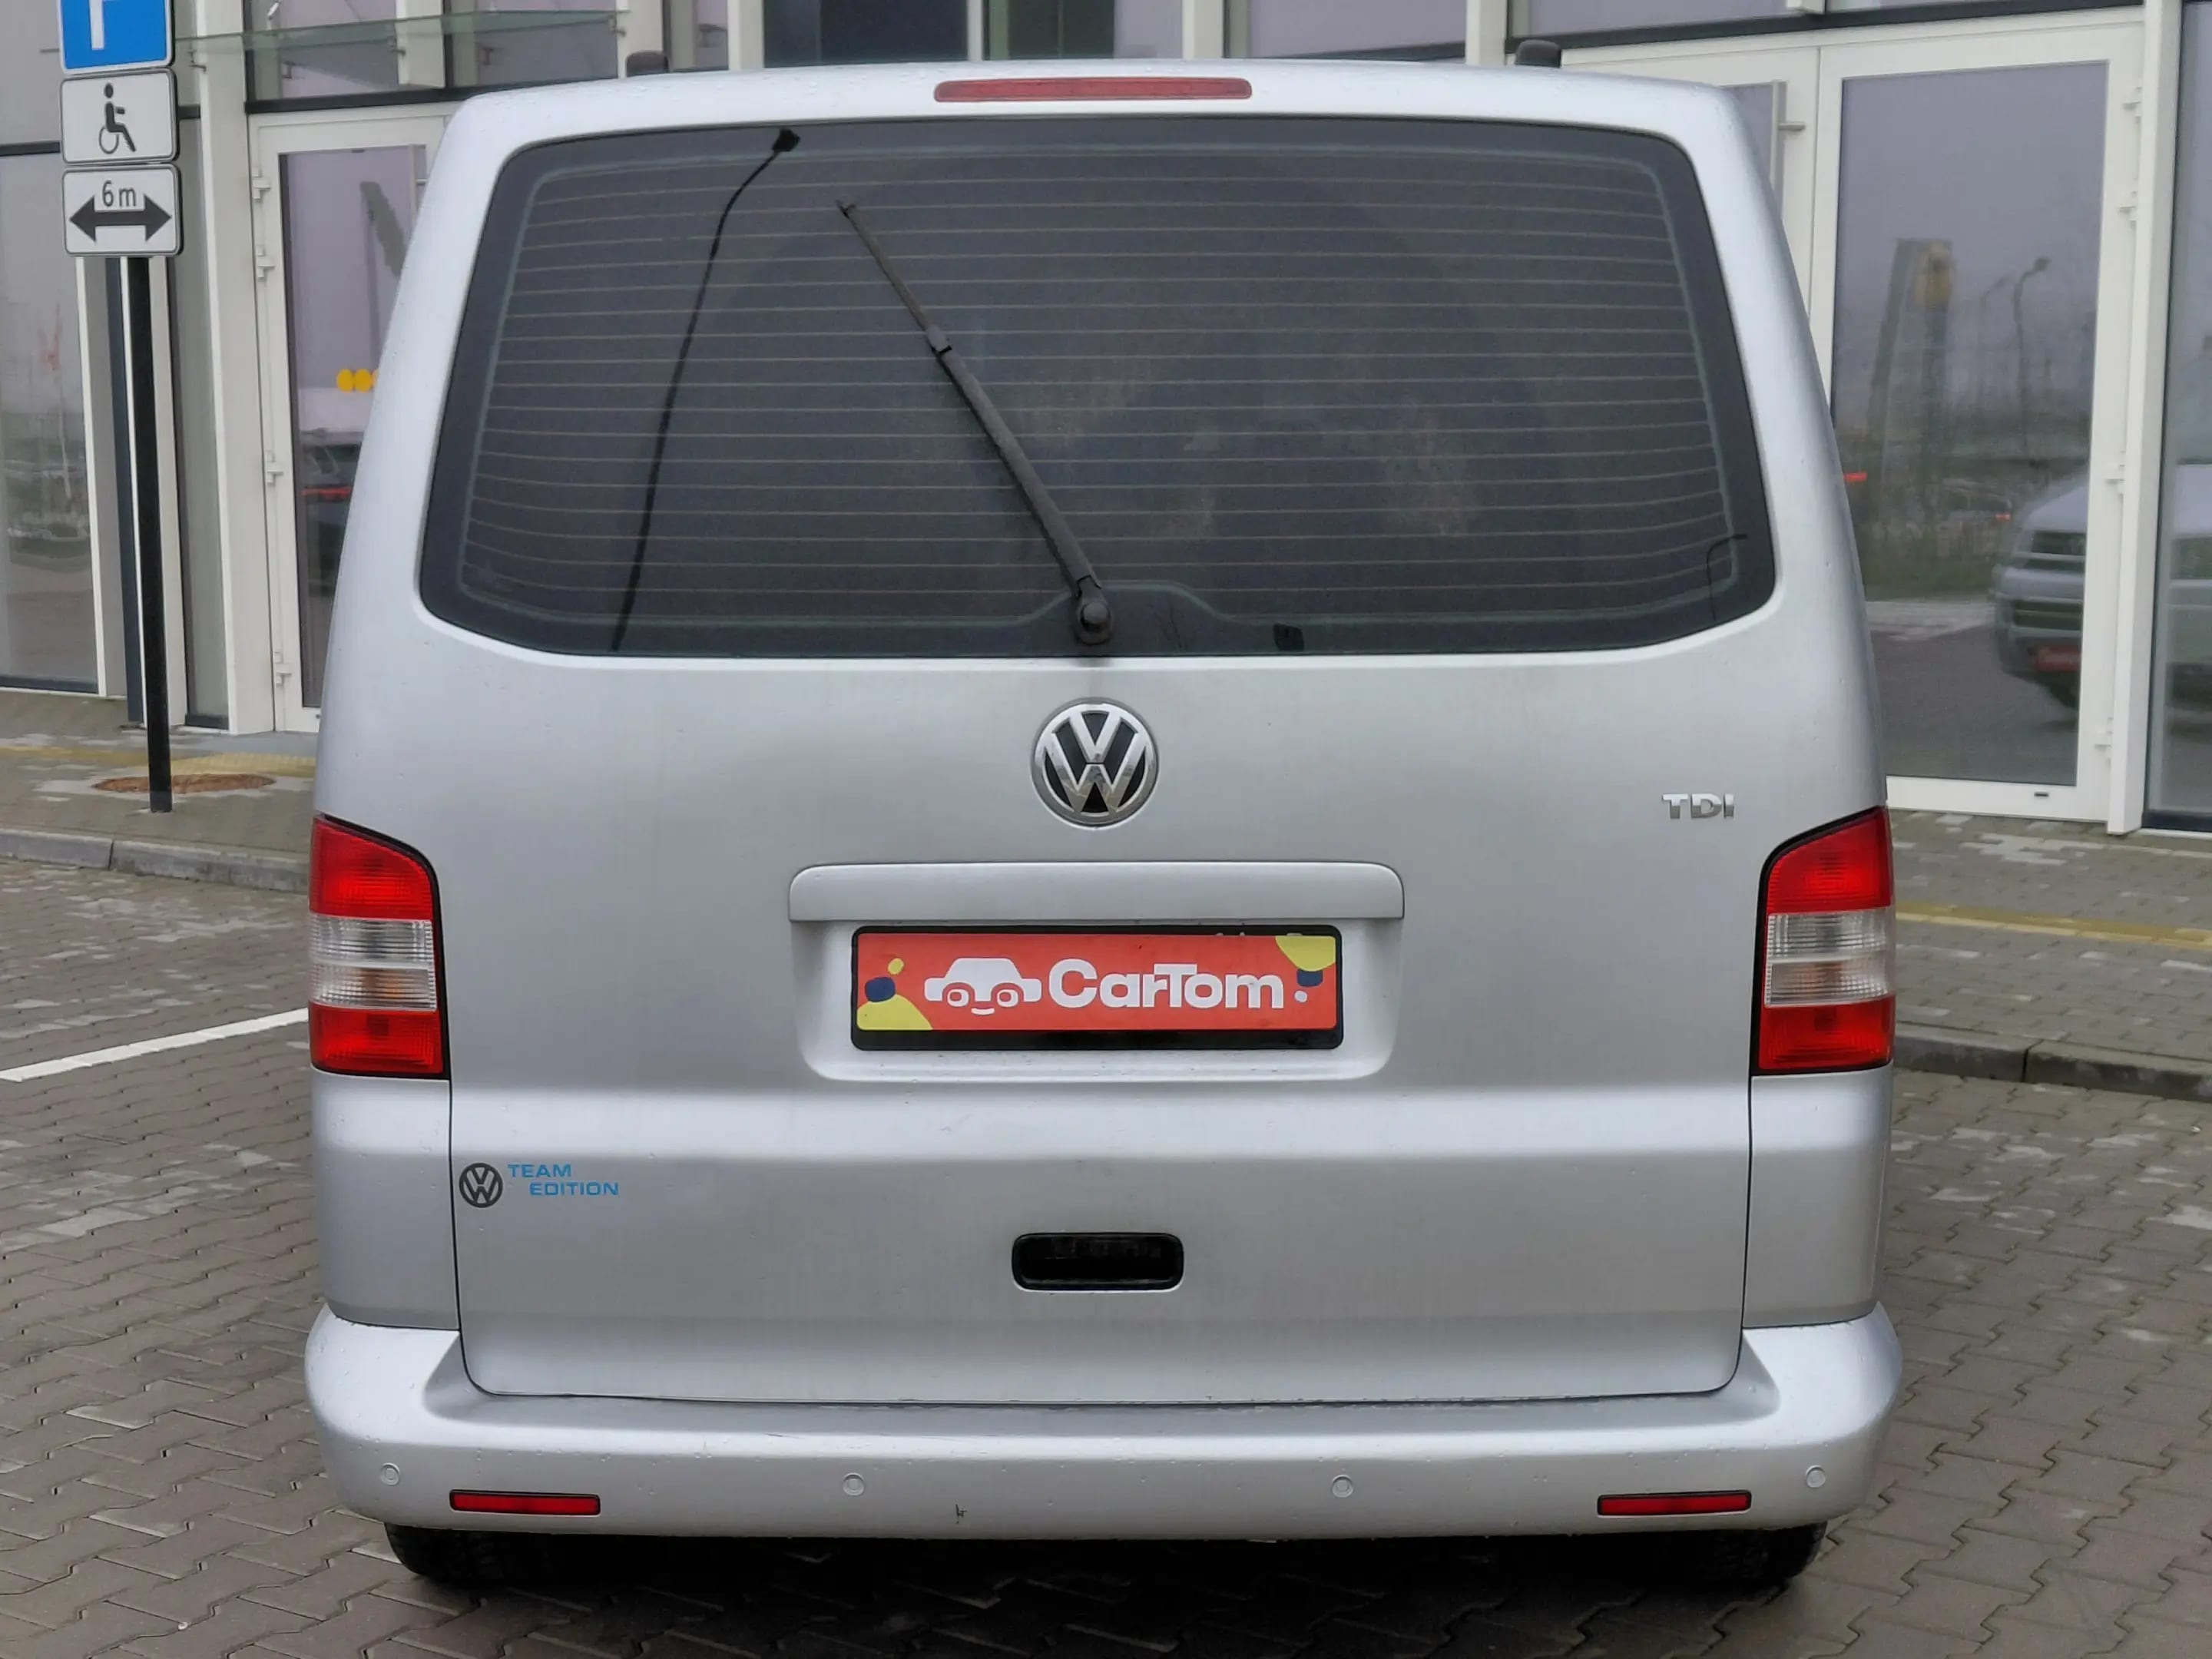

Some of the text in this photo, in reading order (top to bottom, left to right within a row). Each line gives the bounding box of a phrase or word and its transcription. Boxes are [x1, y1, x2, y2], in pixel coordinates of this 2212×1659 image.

[1034, 702, 1157, 825] VW
[1661, 793, 1734, 820] TDI
[1048, 958, 1284, 1009] CarTom
[459, 1162, 504, 1208] VW
[508, 1164, 572, 1178] TEAM
[529, 1182, 620, 1196] EDITION
